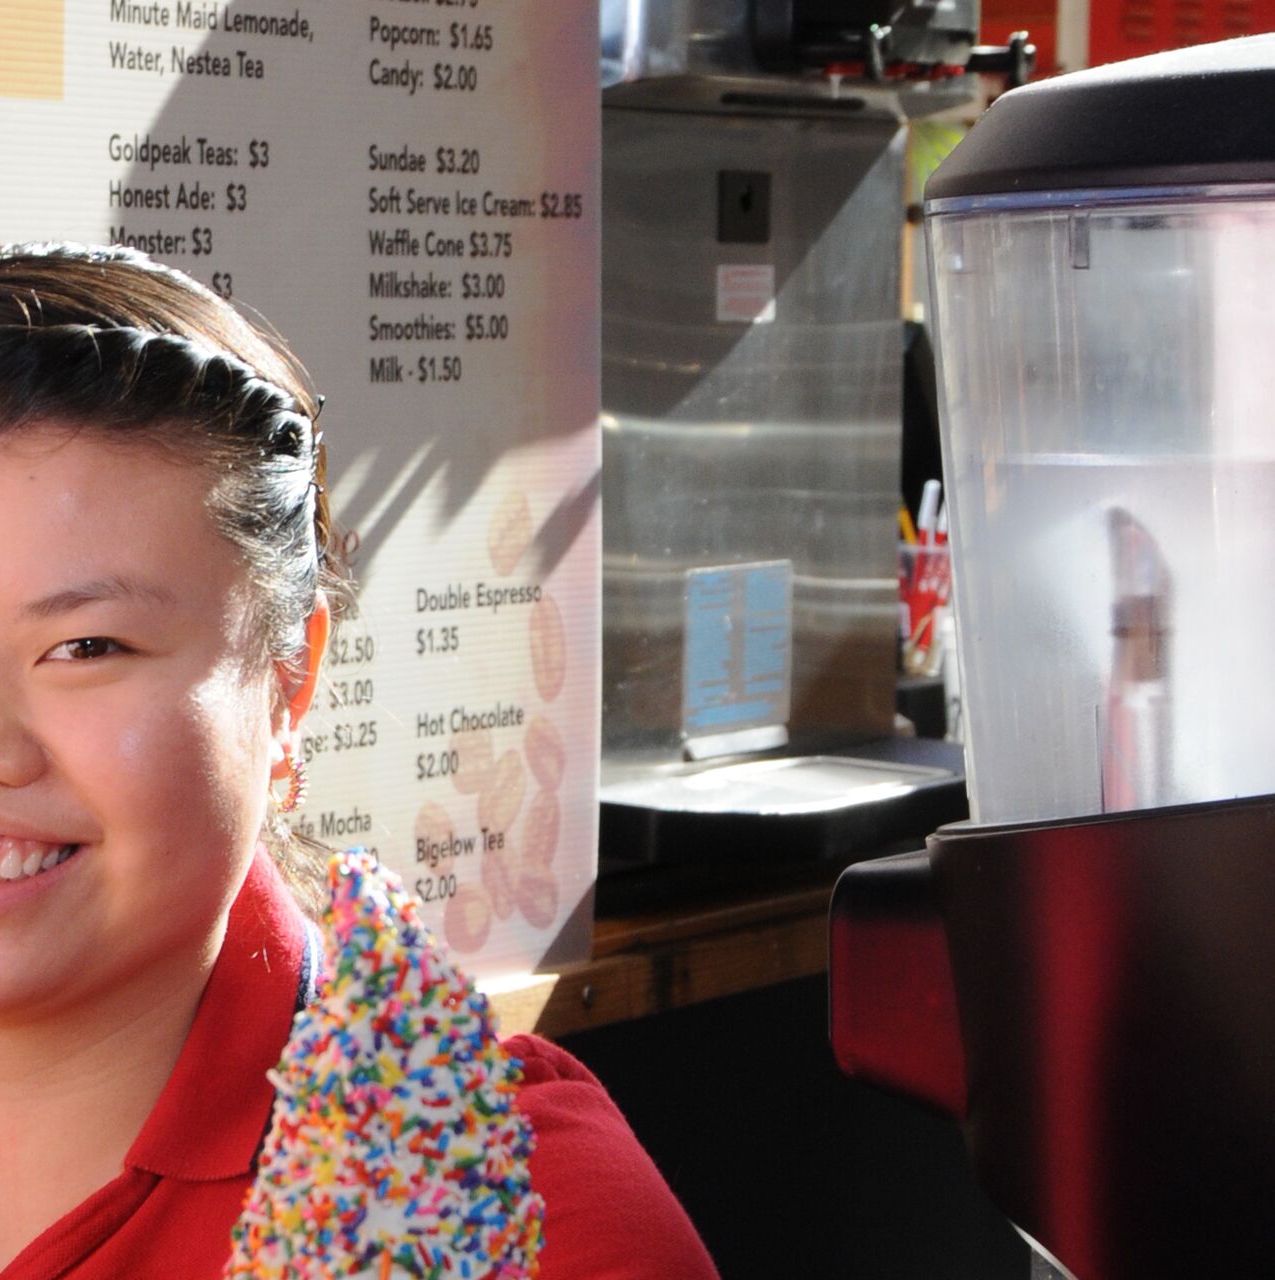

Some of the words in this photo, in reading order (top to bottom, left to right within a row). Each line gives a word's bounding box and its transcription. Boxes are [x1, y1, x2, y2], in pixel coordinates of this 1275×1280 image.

[176, 0, 218, 32] Maid
[223, 4, 314, 43] Lemonade,
[369, 16, 441, 52] Popcorn:
[450, 22, 494, 51] $1.65
[109, 41, 165, 77] Water,
[171, 46, 231, 78] Nestea
[236, 50, 265, 80] Tea
[369, 58, 424, 95] Candy:
[433, 62, 478, 92] $2.00
[109, 133, 192, 171] Goldpeak
[197, 137, 239, 167] Teas:
[248, 138, 271, 169] $3
[369, 144, 427, 172] Sundae
[436, 146, 481, 175] $3.20
[109, 180, 171, 210] Honest
[175, 181, 216, 211] Ade:
[226, 180, 248, 212] $3
[368, 185, 402, 214] Soft
[406, 188, 451, 215] Serve
[455, 190, 478, 216] Ice
[482, 190, 536, 217] Cream:
[539, 191, 583, 219] $2.85
[109, 225, 187, 256] Monster:
[191, 226, 214, 258] $3
[368, 228, 420, 257] Waffle
[424, 230, 465, 258] Cone
[469, 230, 513, 258] $3.75
[212, 271, 234, 302] $3
[368, 271, 452, 299] Milkshake:
[461, 272, 506, 299] $3.00
[368, 314, 456, 342] Smoothies:
[465, 313, 509, 341] $5.00
[369, 356, 404, 383] Milk
[417, 355, 463, 383] $1.50
[415, 587, 471, 614] Double
[476, 582, 543, 614] Espresso
[415, 626, 460, 655] $1.35
[416, 713, 445, 739] Hot
[450, 704, 525, 733] Chocolate
[416, 750, 460, 780] $2.00
[320, 806, 372, 838] Mocha
[415, 835, 475, 869] Bigelow
[480, 827, 506, 852] Tea
[415, 875, 458, 904] $2.00
